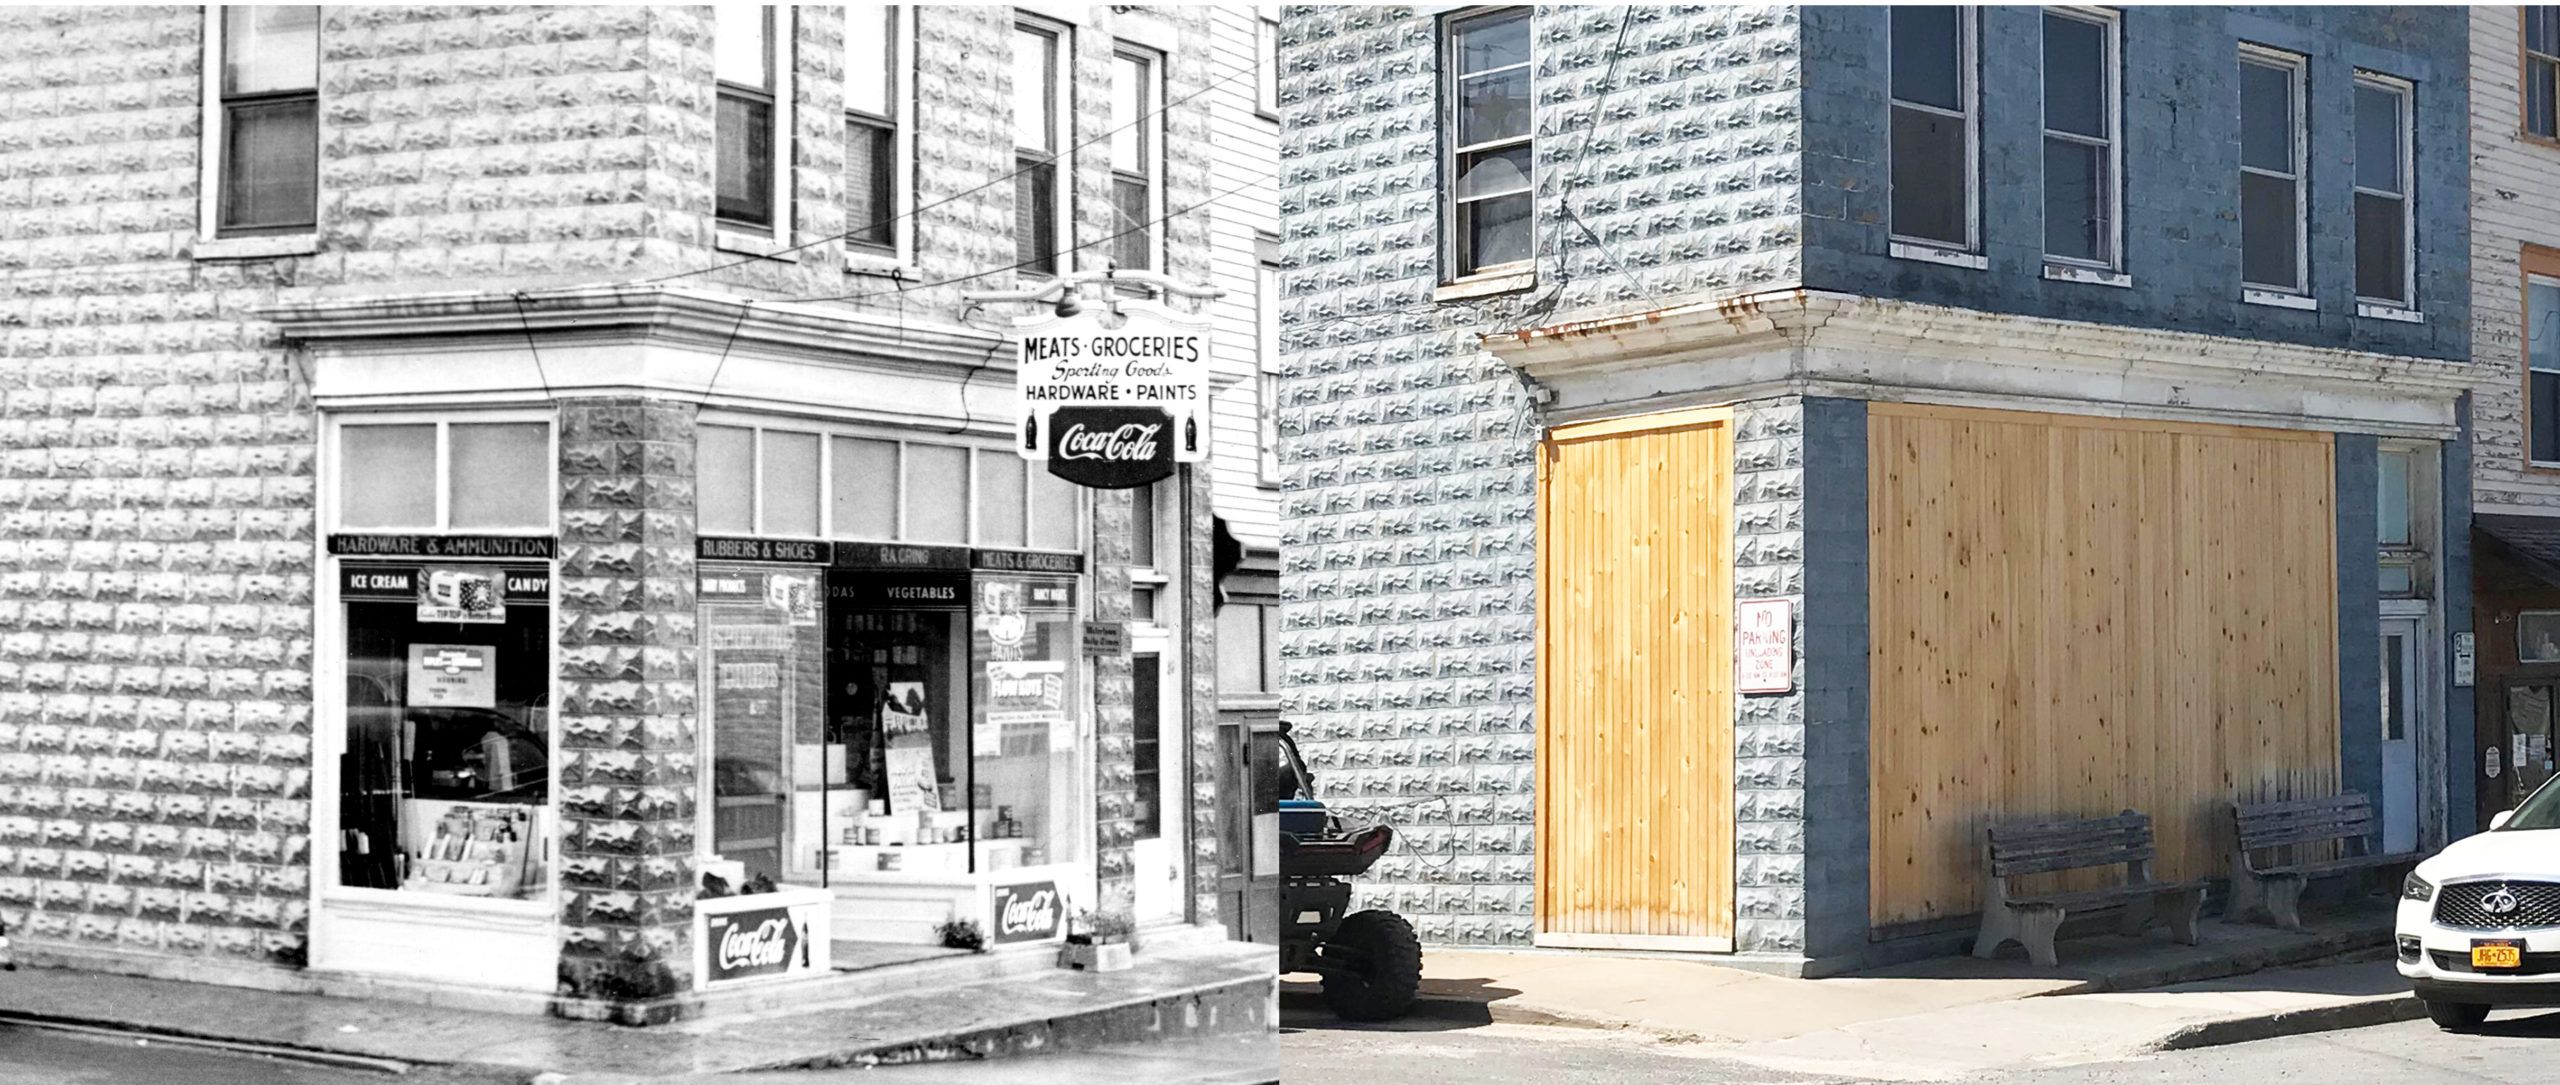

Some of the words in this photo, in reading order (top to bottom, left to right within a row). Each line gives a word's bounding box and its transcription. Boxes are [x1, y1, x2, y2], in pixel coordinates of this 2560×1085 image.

[1025, 337, 1080, 364] MEATS
[1091, 336, 1199, 362] GROCERIES
[1052, 359, 1119, 383] Sporting
[1026, 385, 1119, 400] HARDWARE
[1137, 385, 1197, 400] PAINTS
[337, 536, 420, 553] HARDWARE
[427, 538, 440, 554] &
[444, 538, 548, 554] AMMUNITION
[703, 540, 759, 557] RUBBERS
[763, 541, 772, 558] &
[775, 542, 816, 559] SHOES
[982, 551, 1014, 568] MEATS
[1016, 553, 1024, 569] &
[1025, 554, 1076, 570] GROCERIES
[351, 575, 369, 588] ICE
[370, 575, 409, 589] CREAM
[507, 577, 548, 591] CANDY
[887, 587, 955, 599] VEGETABLES
[1757, 610, 1772, 627] NO
[1742, 630, 1786, 645] PARING
